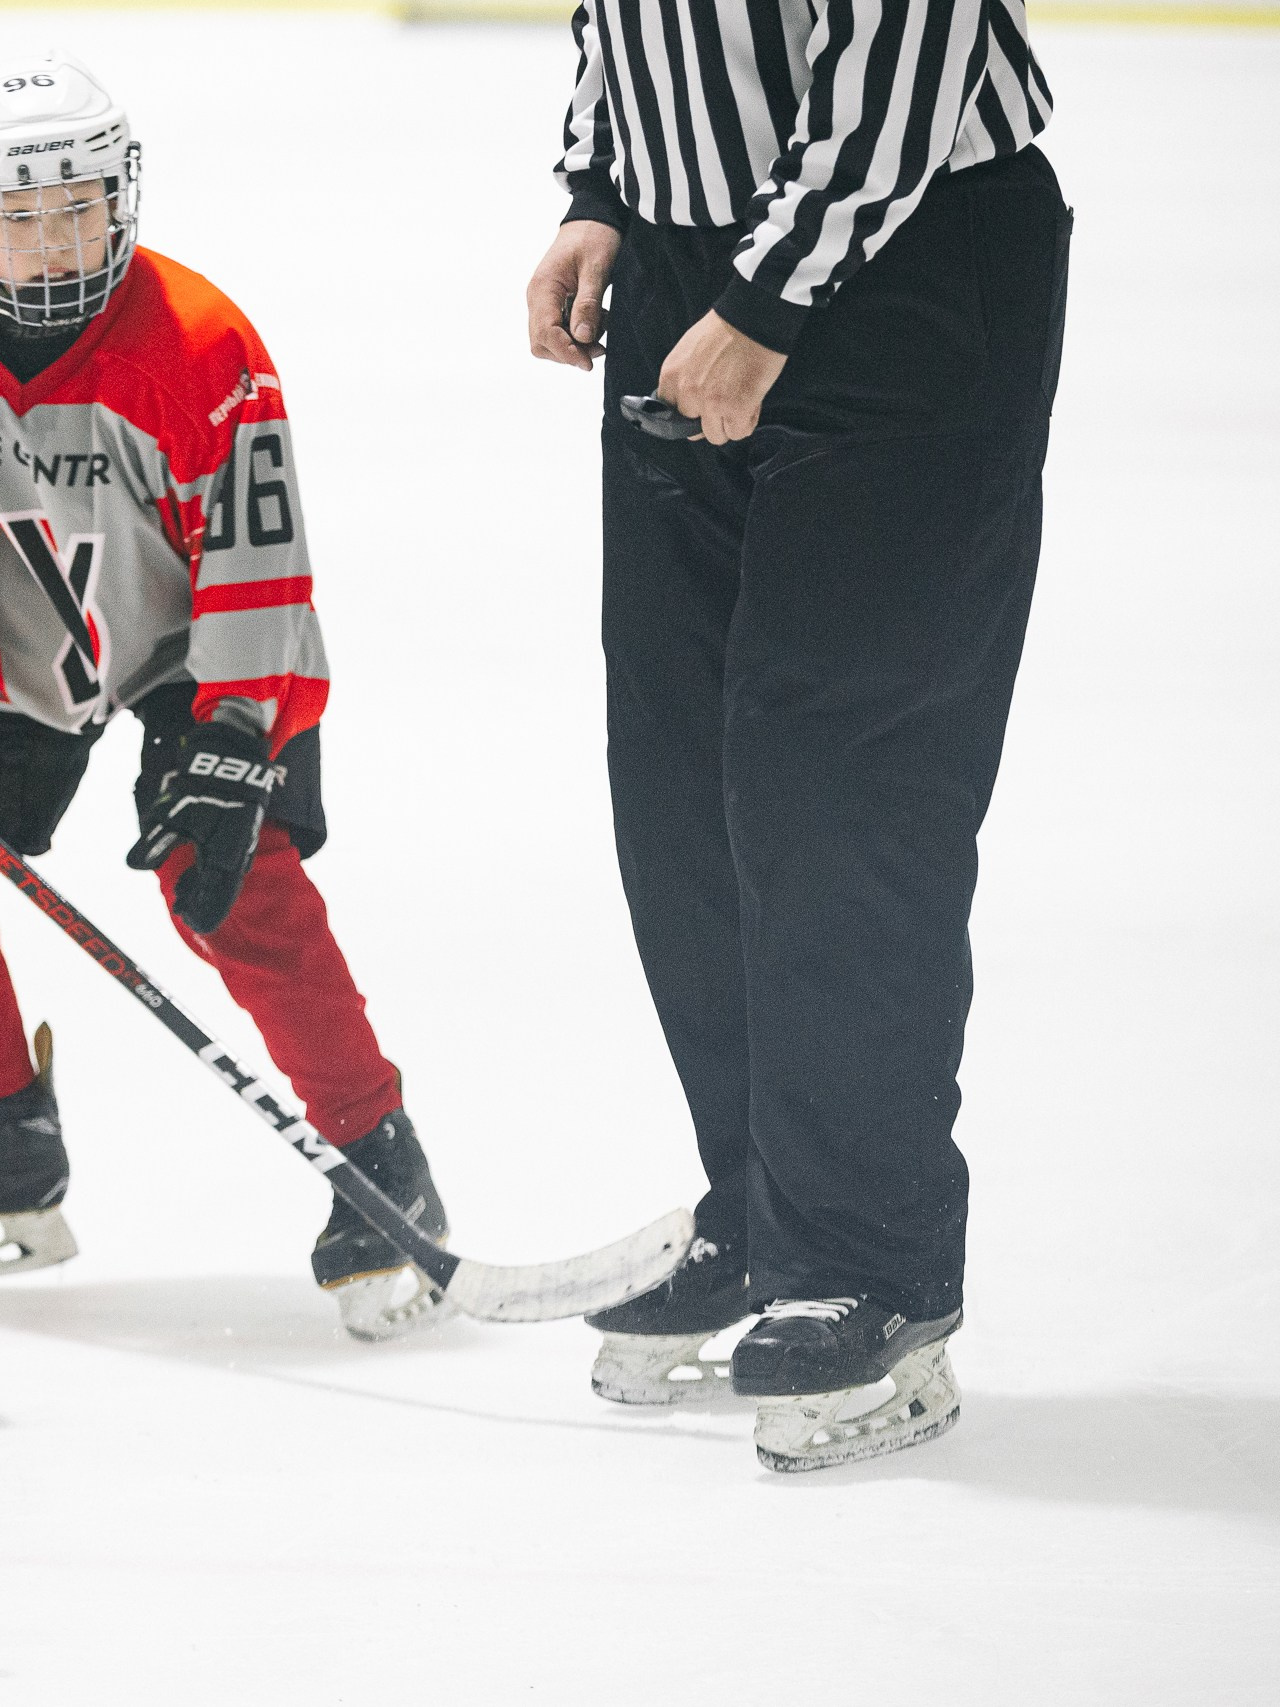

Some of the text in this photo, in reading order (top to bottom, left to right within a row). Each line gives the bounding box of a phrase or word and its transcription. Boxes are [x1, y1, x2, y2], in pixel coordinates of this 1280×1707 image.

[3, 74, 56, 93] 96
[7, 139, 75, 156] BAUER
[198, 1042, 348, 1174] CCM
[883, 1313, 907, 1340] BAU
